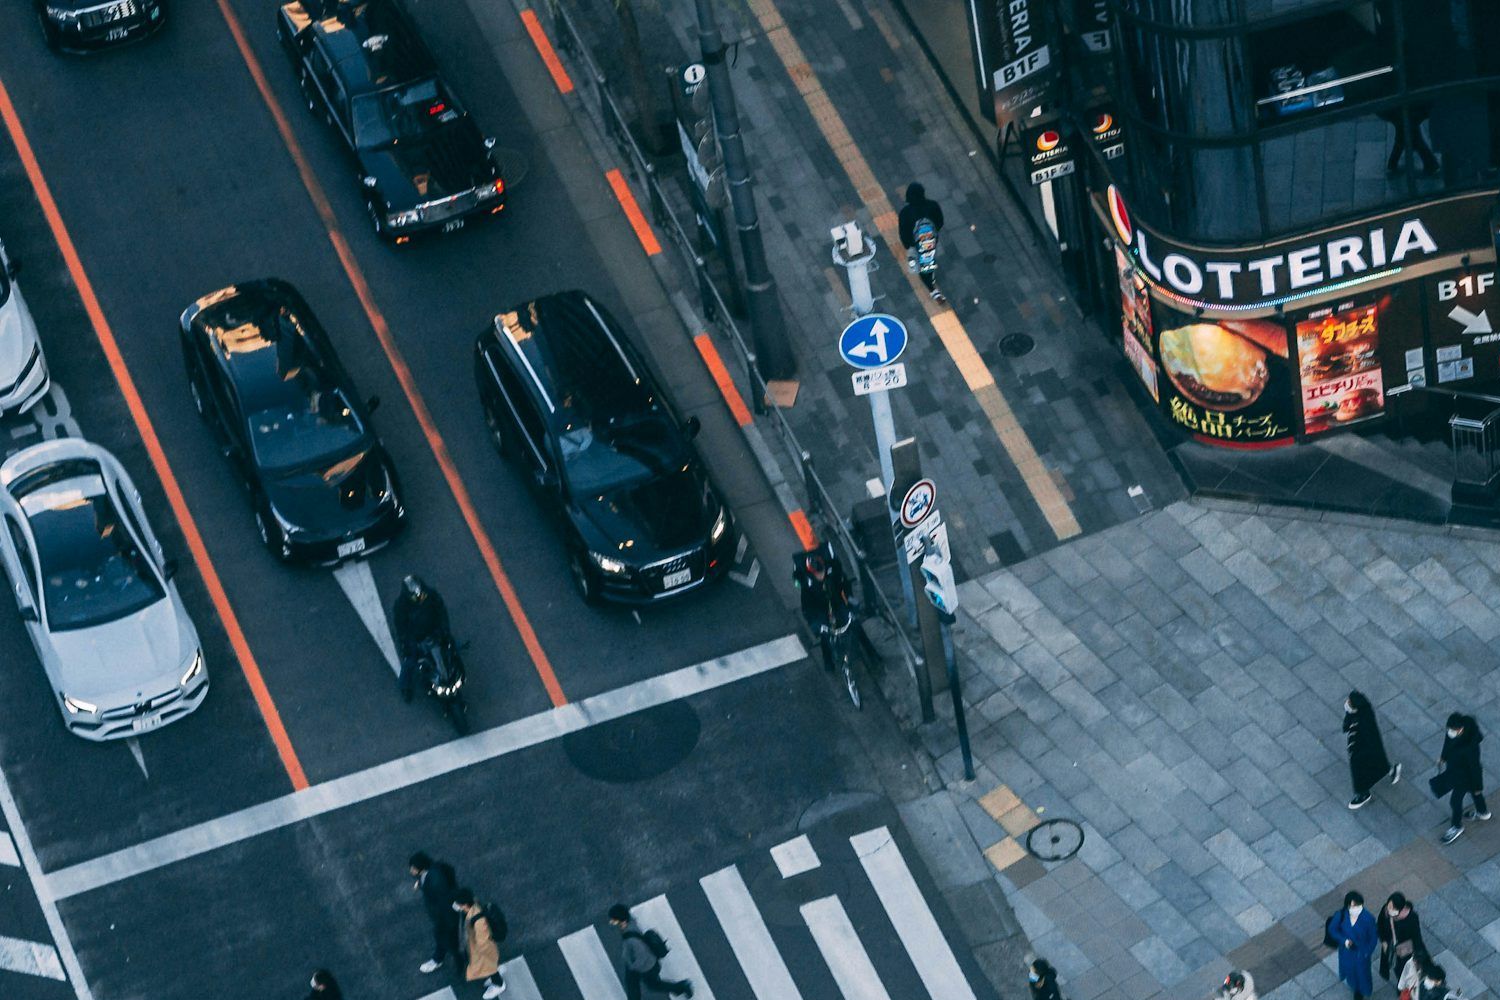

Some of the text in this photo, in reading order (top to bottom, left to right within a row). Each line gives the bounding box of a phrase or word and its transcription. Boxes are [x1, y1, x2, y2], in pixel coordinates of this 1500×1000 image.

[1003, 52, 1039, 84] B1F
[1031, 146, 1068, 162] LOTTERIA
[1035, 166, 1058, 182] B1F
[1136, 218, 1438, 299] LOTTERIA
[1438, 272, 1495, 301] B1F
[1170, 396, 1233, 438] 絶品
